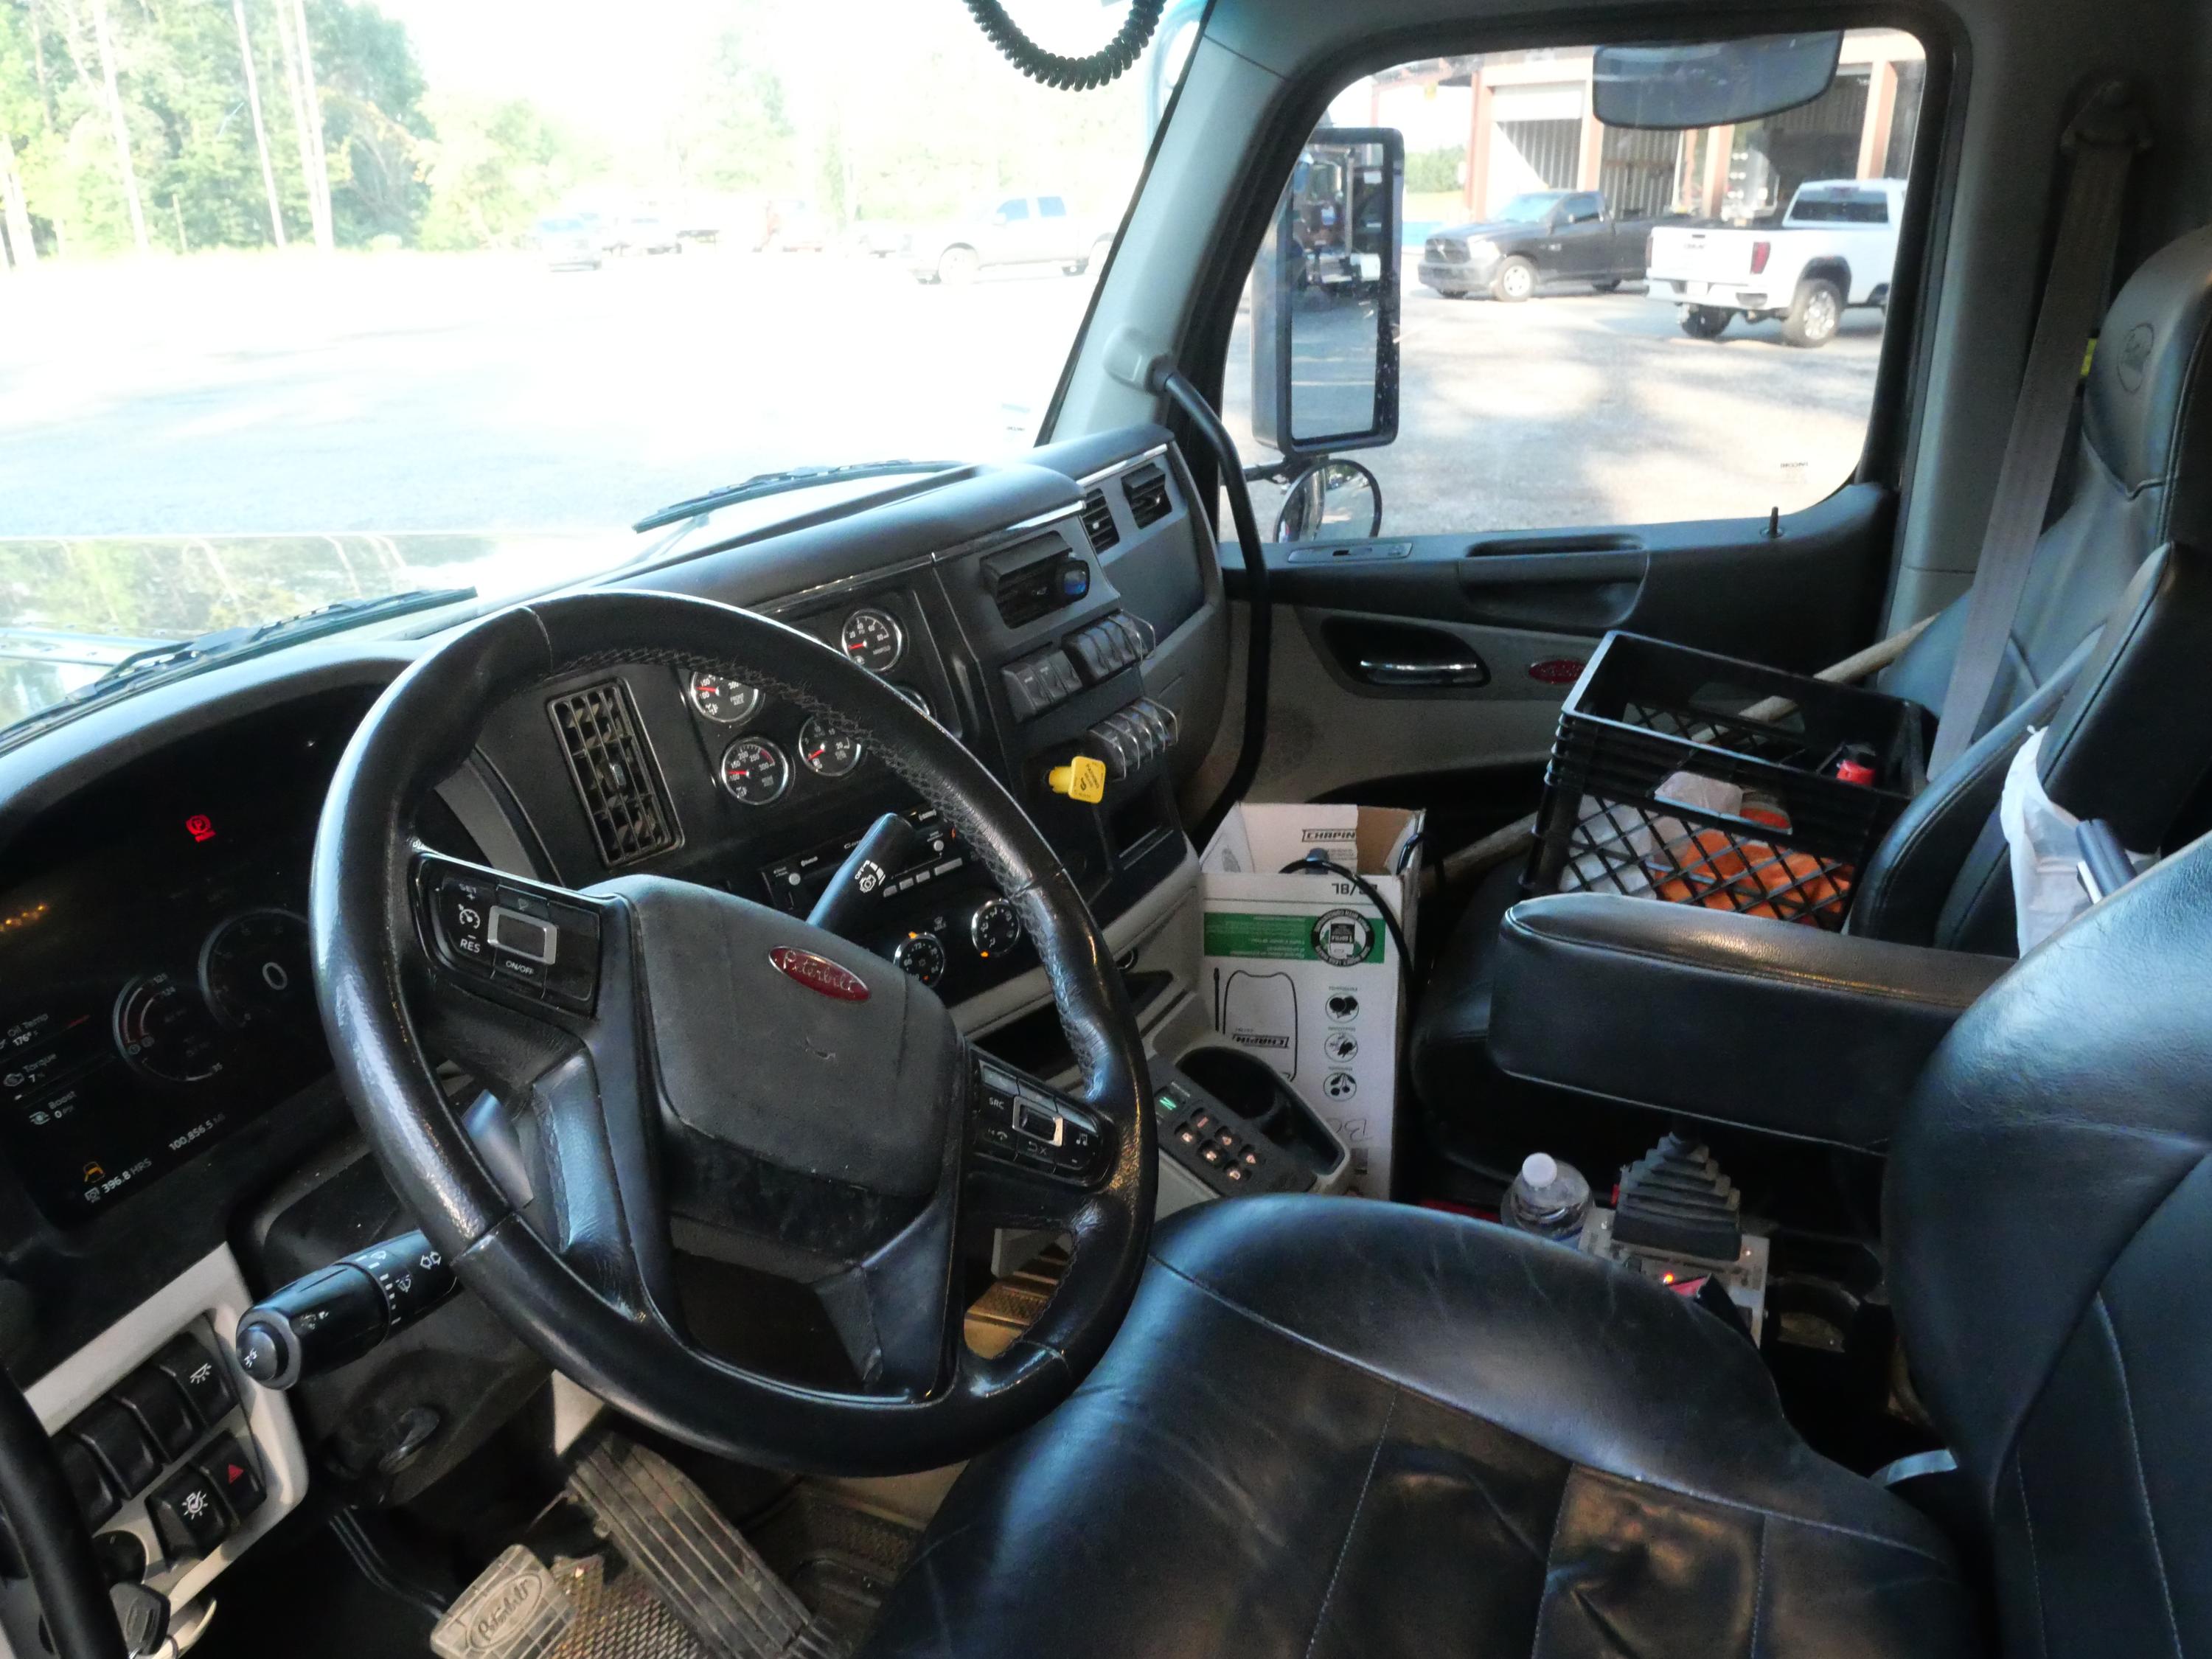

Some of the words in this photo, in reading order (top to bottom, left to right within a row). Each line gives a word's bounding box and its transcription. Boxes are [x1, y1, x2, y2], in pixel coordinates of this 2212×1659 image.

[459, 937, 481, 953] RES
[262, 961, 288, 990] 0
[506, 960, 535, 975] ON/OFF
[7, 1024, 22, 1037] Oil
[23, 1054, 57, 1073] Torque
[48, 1091, 77, 1109] Boost
[988, 1096, 1004, 1110] SRC
[168, 1119, 214, 1151] 100,856.5
[100, 1169, 132, 1194] 396.8
[129, 1157, 153, 1176] HRS
